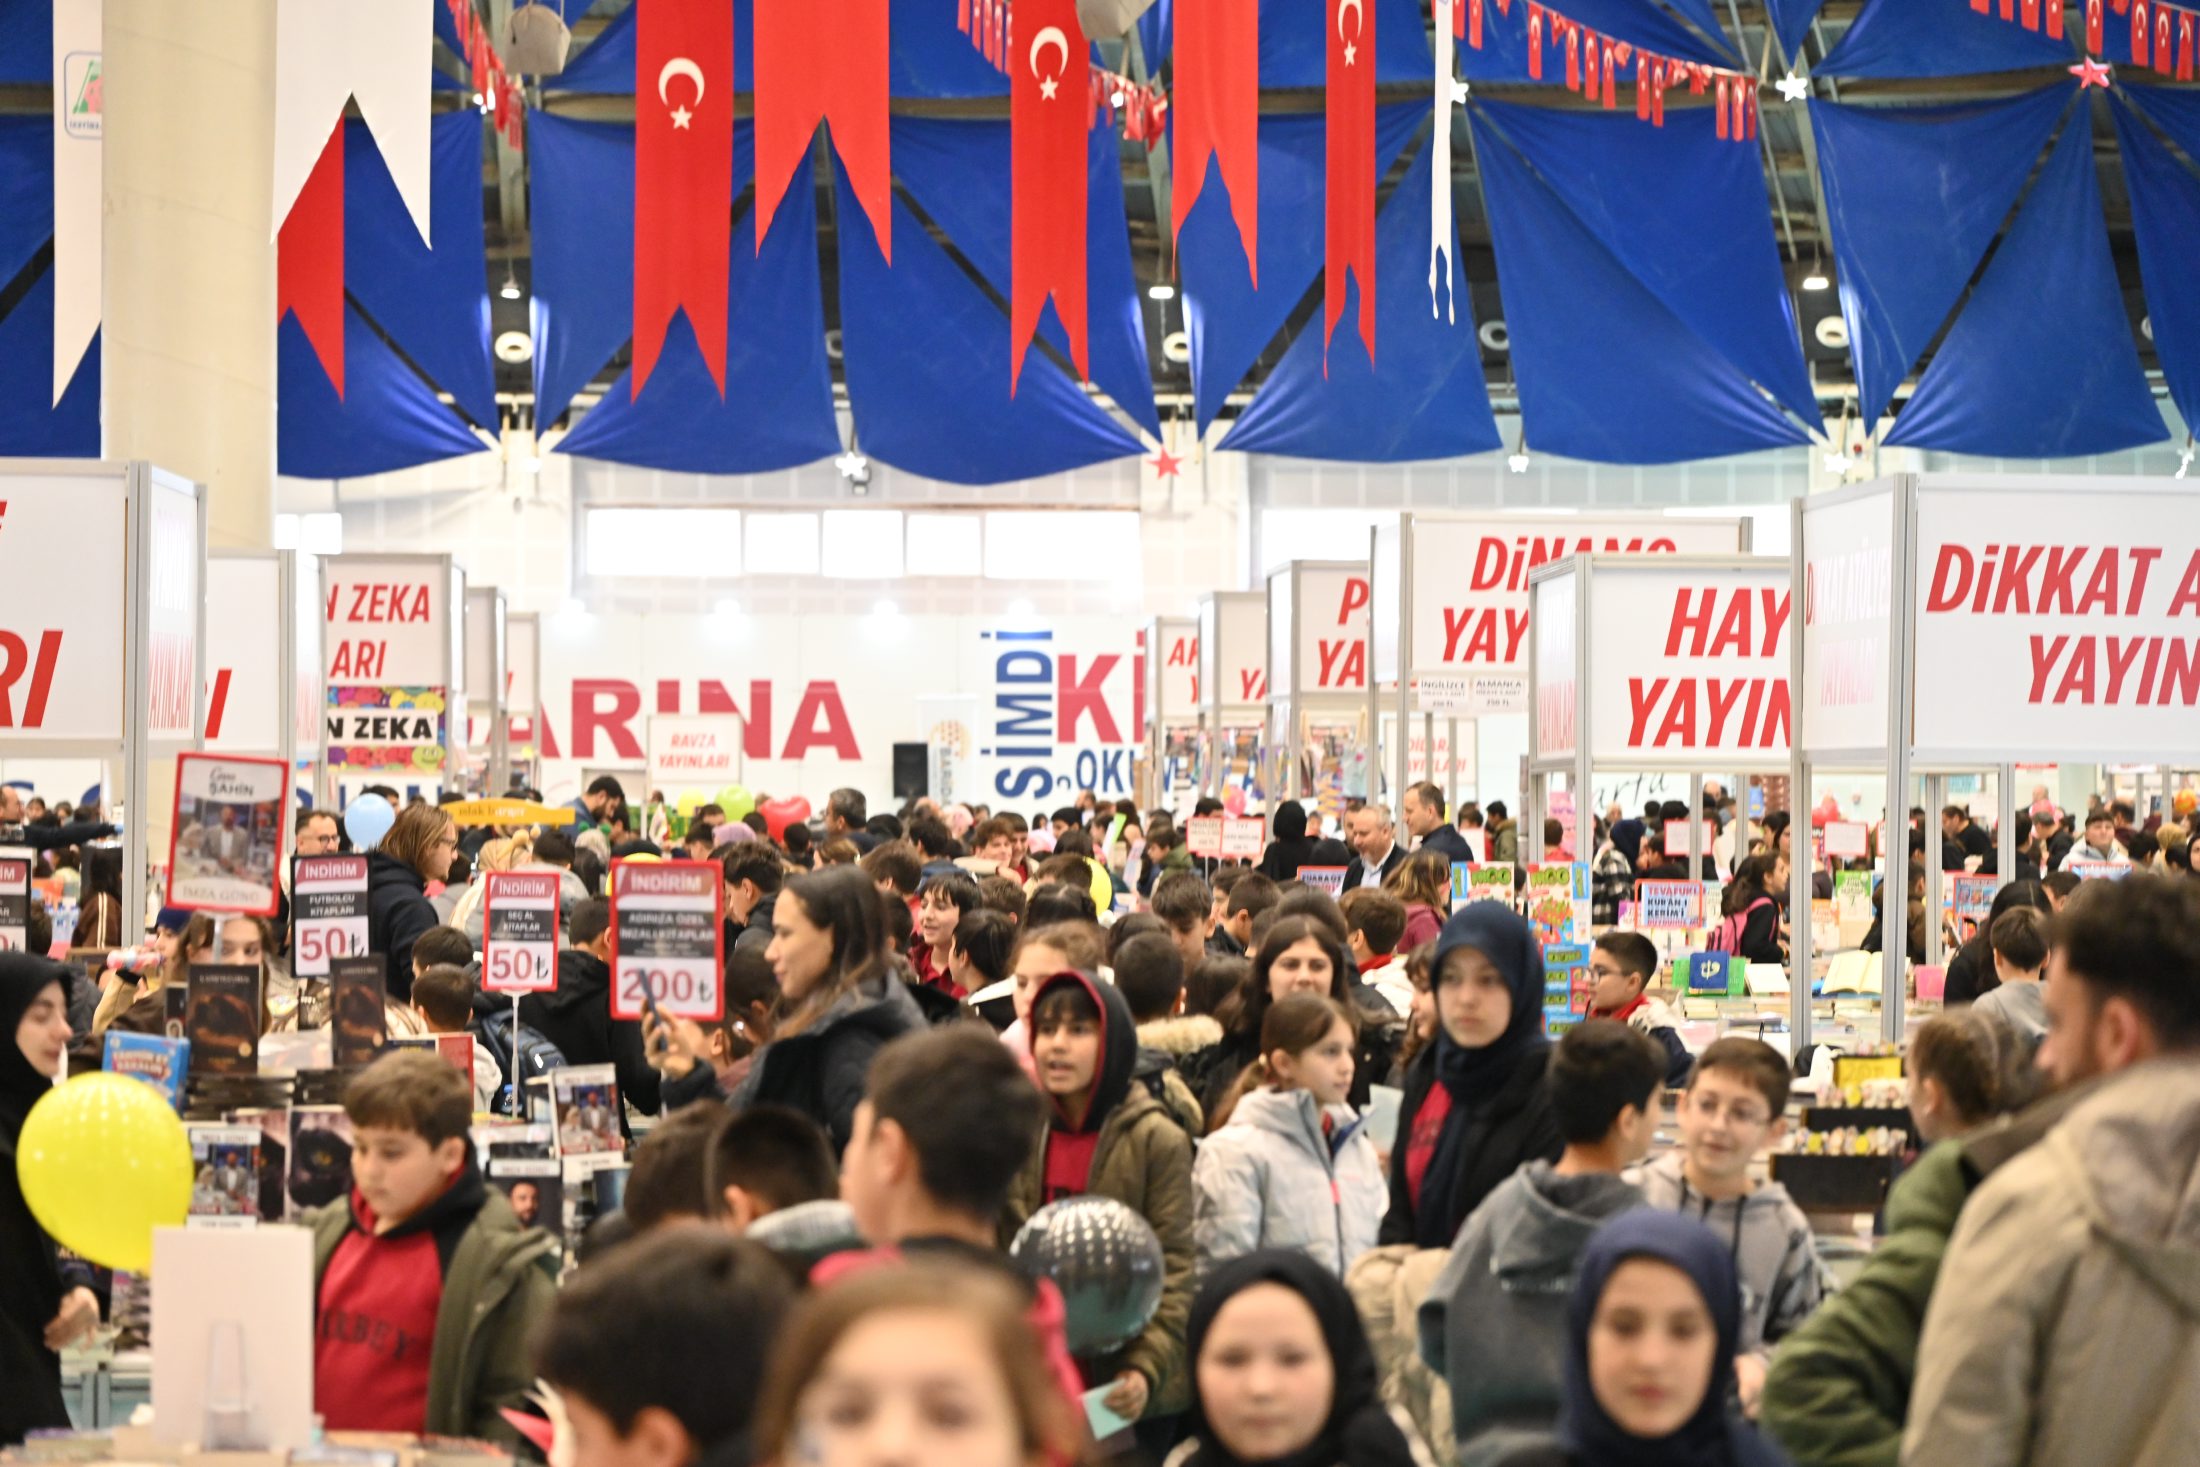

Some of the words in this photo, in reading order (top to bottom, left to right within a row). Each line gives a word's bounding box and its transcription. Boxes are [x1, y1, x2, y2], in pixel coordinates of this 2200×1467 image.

[346, 584, 431, 623] ZEKA
[353, 716, 433, 740] ZEKA
[671, 733, 716, 748] RAVZA
[658, 754, 730, 769] YAYINLARI
[305, 862, 357, 880] İNDİRİM
[499, 879, 546, 896] İNDİRİM
[630, 872, 701, 891] İNDİRİM
